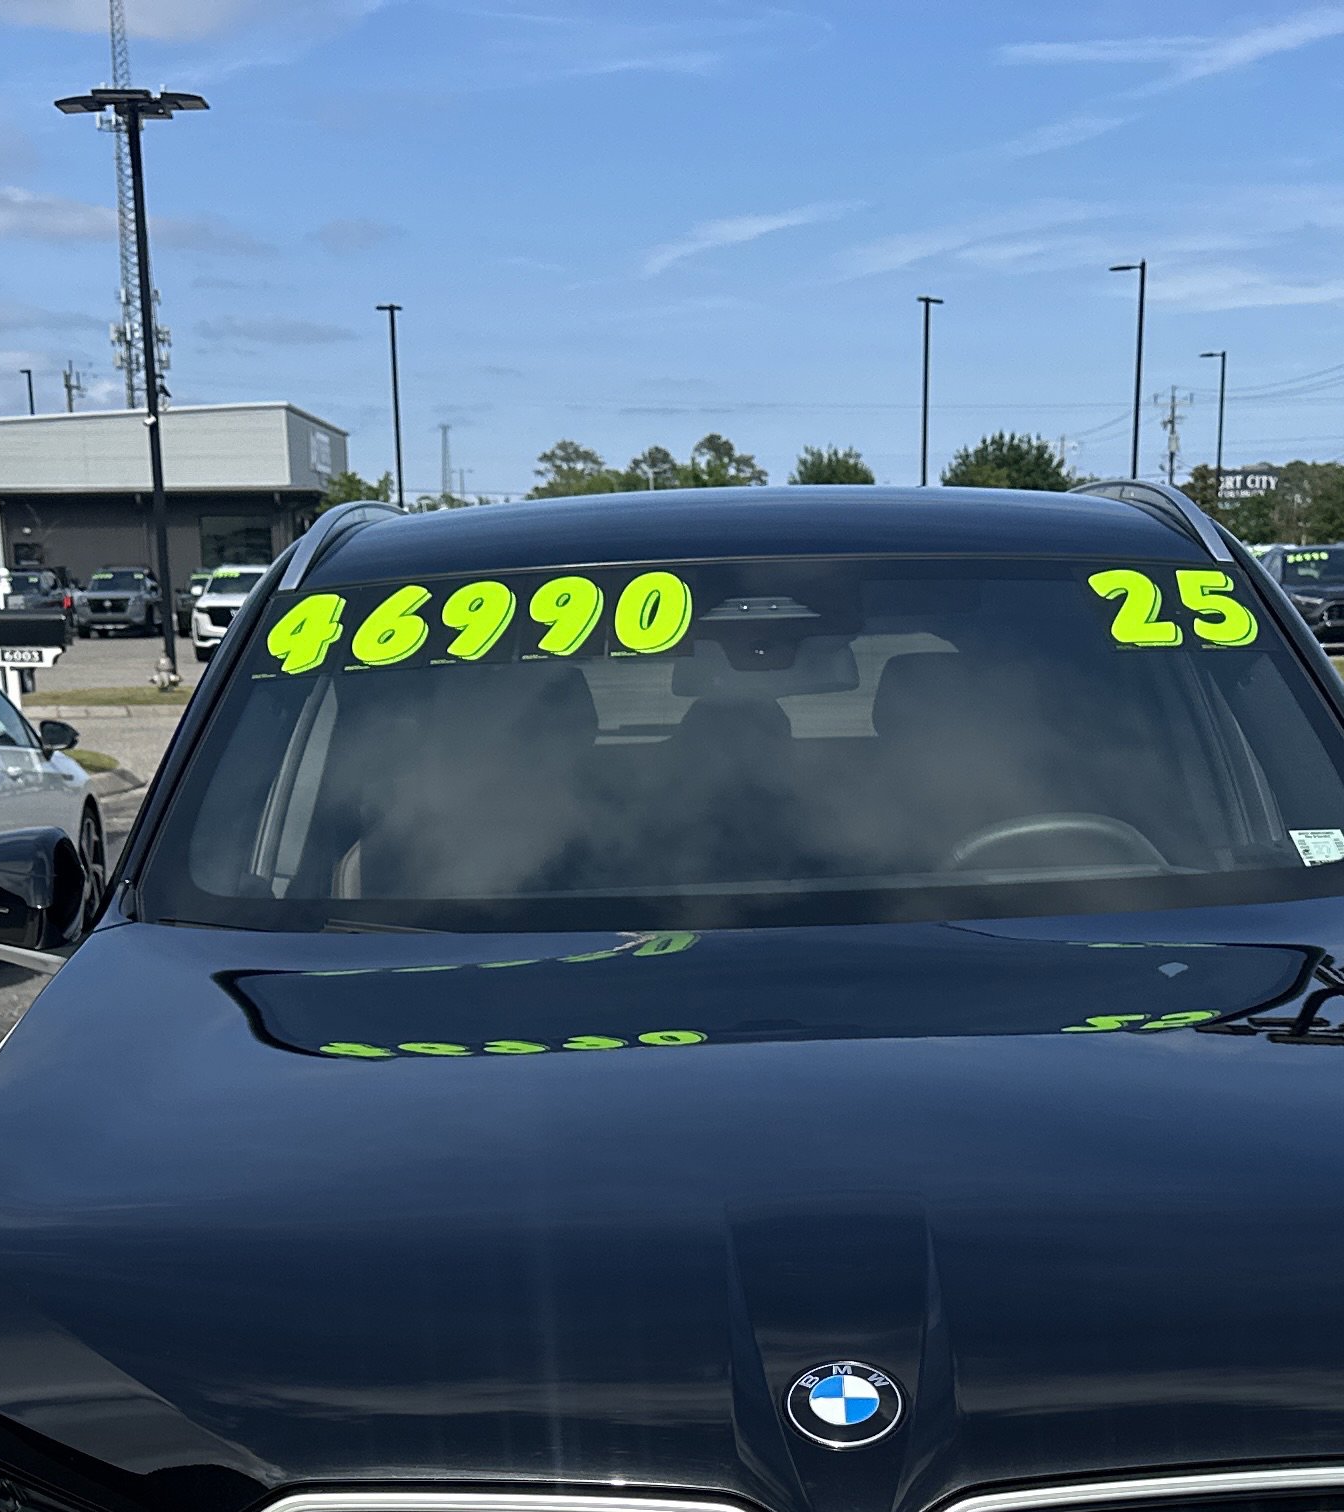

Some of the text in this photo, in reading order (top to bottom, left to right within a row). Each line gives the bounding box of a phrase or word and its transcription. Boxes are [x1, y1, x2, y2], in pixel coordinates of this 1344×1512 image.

[1246, 474, 1278, 490] CITY
[1088, 569, 1258, 646] 25
[267, 571, 693, 674] 46990
[4, 650, 40, 661] 6003
[798, 1365, 889, 1388] BMW
